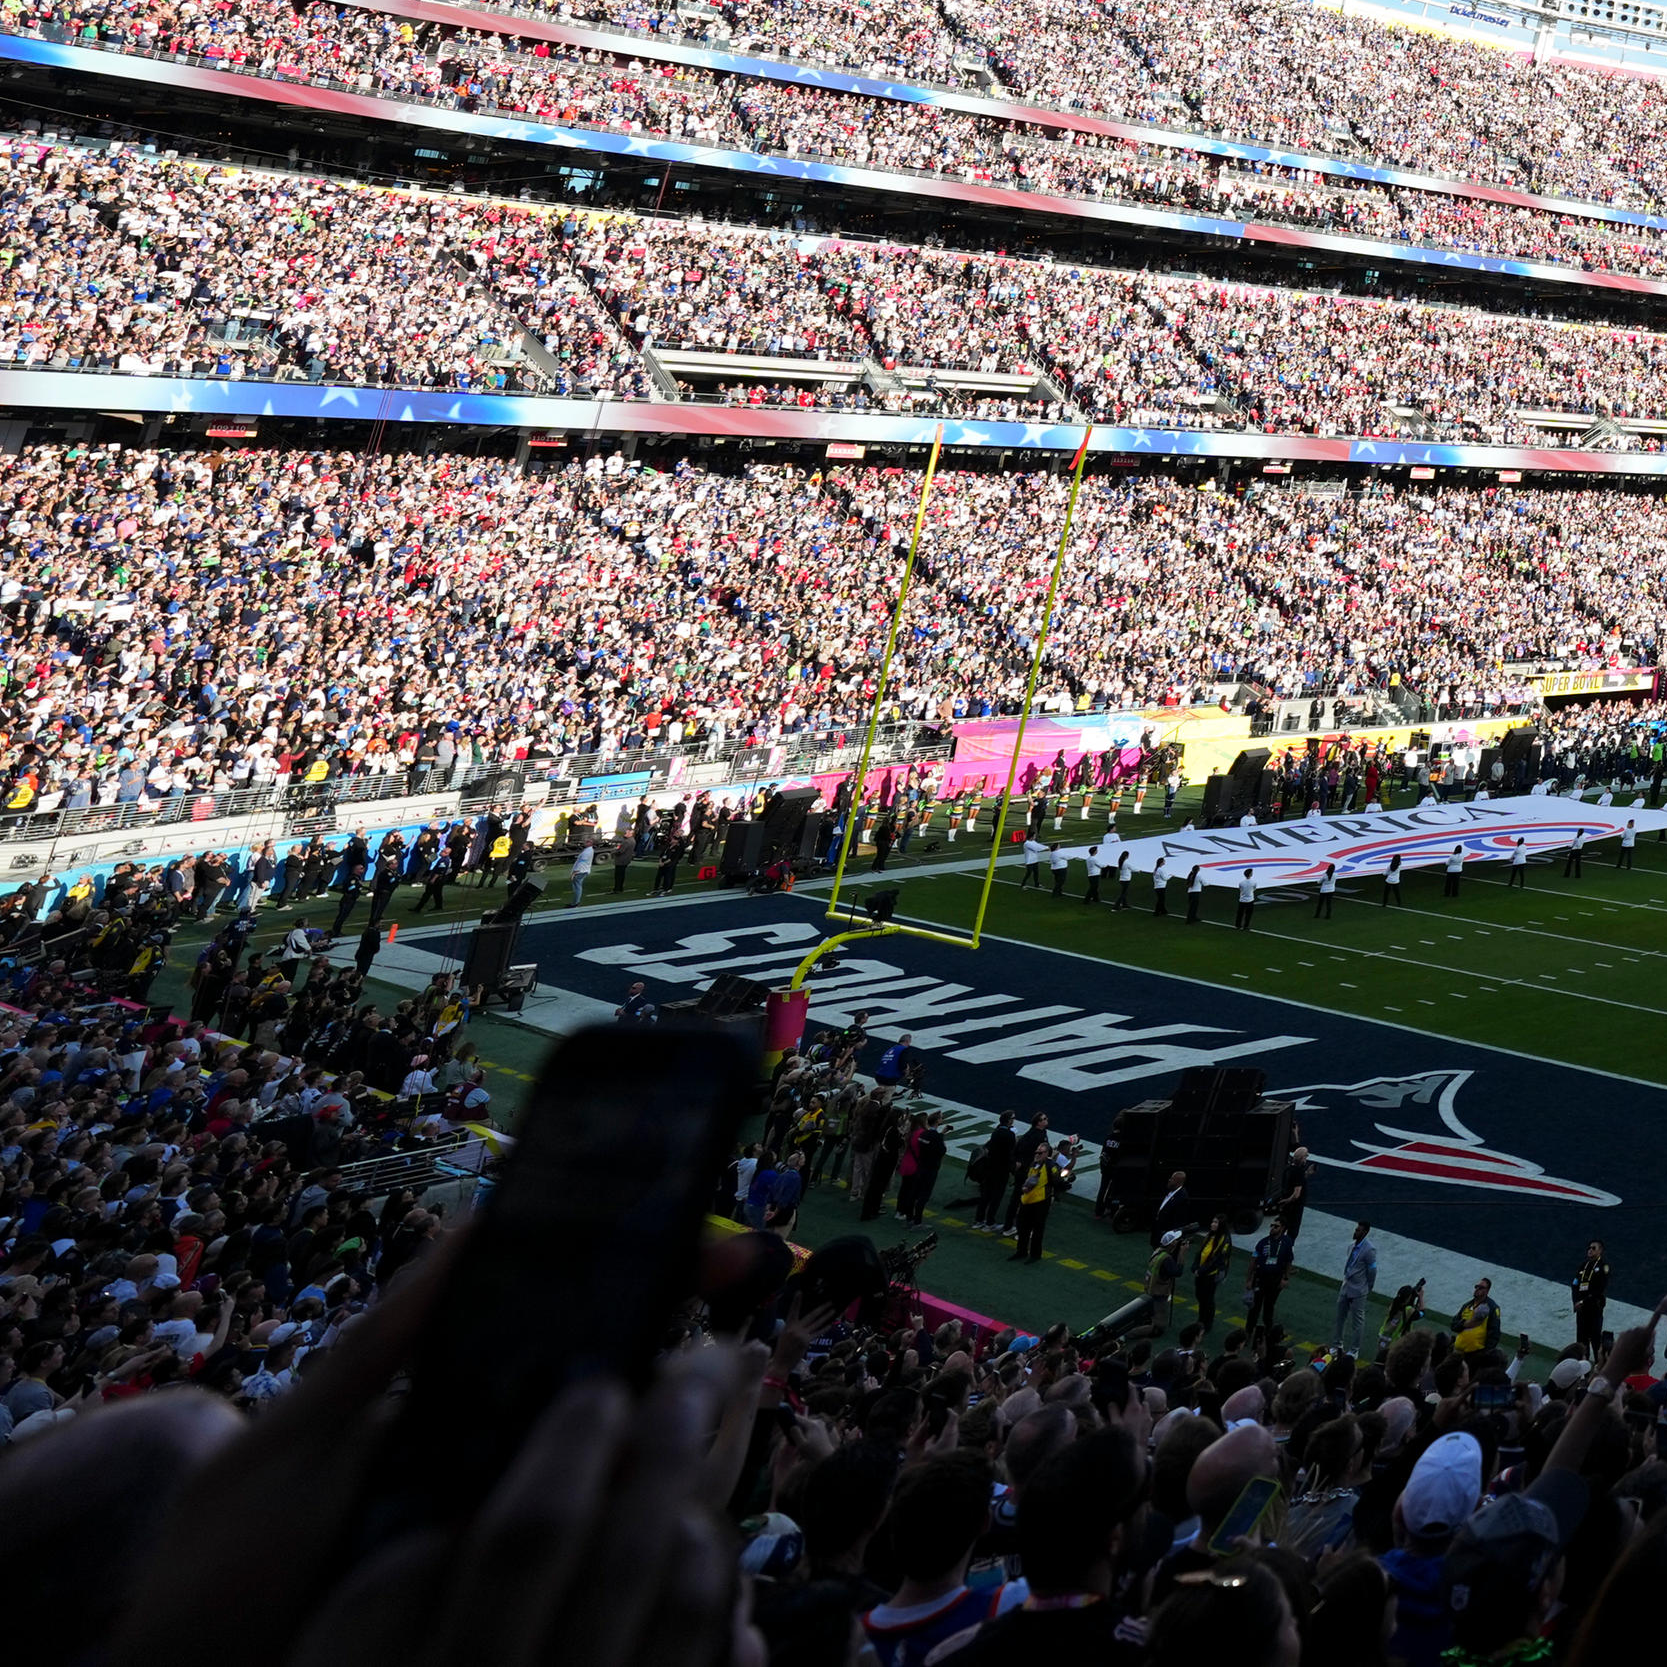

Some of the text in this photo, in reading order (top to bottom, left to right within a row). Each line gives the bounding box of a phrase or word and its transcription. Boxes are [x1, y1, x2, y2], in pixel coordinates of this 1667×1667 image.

[1449, 5, 1511, 27] ticketmaster
[1539, 672, 1642, 693] SUPER BOWL LX
[1155, 801, 1512, 860] AMERICA
